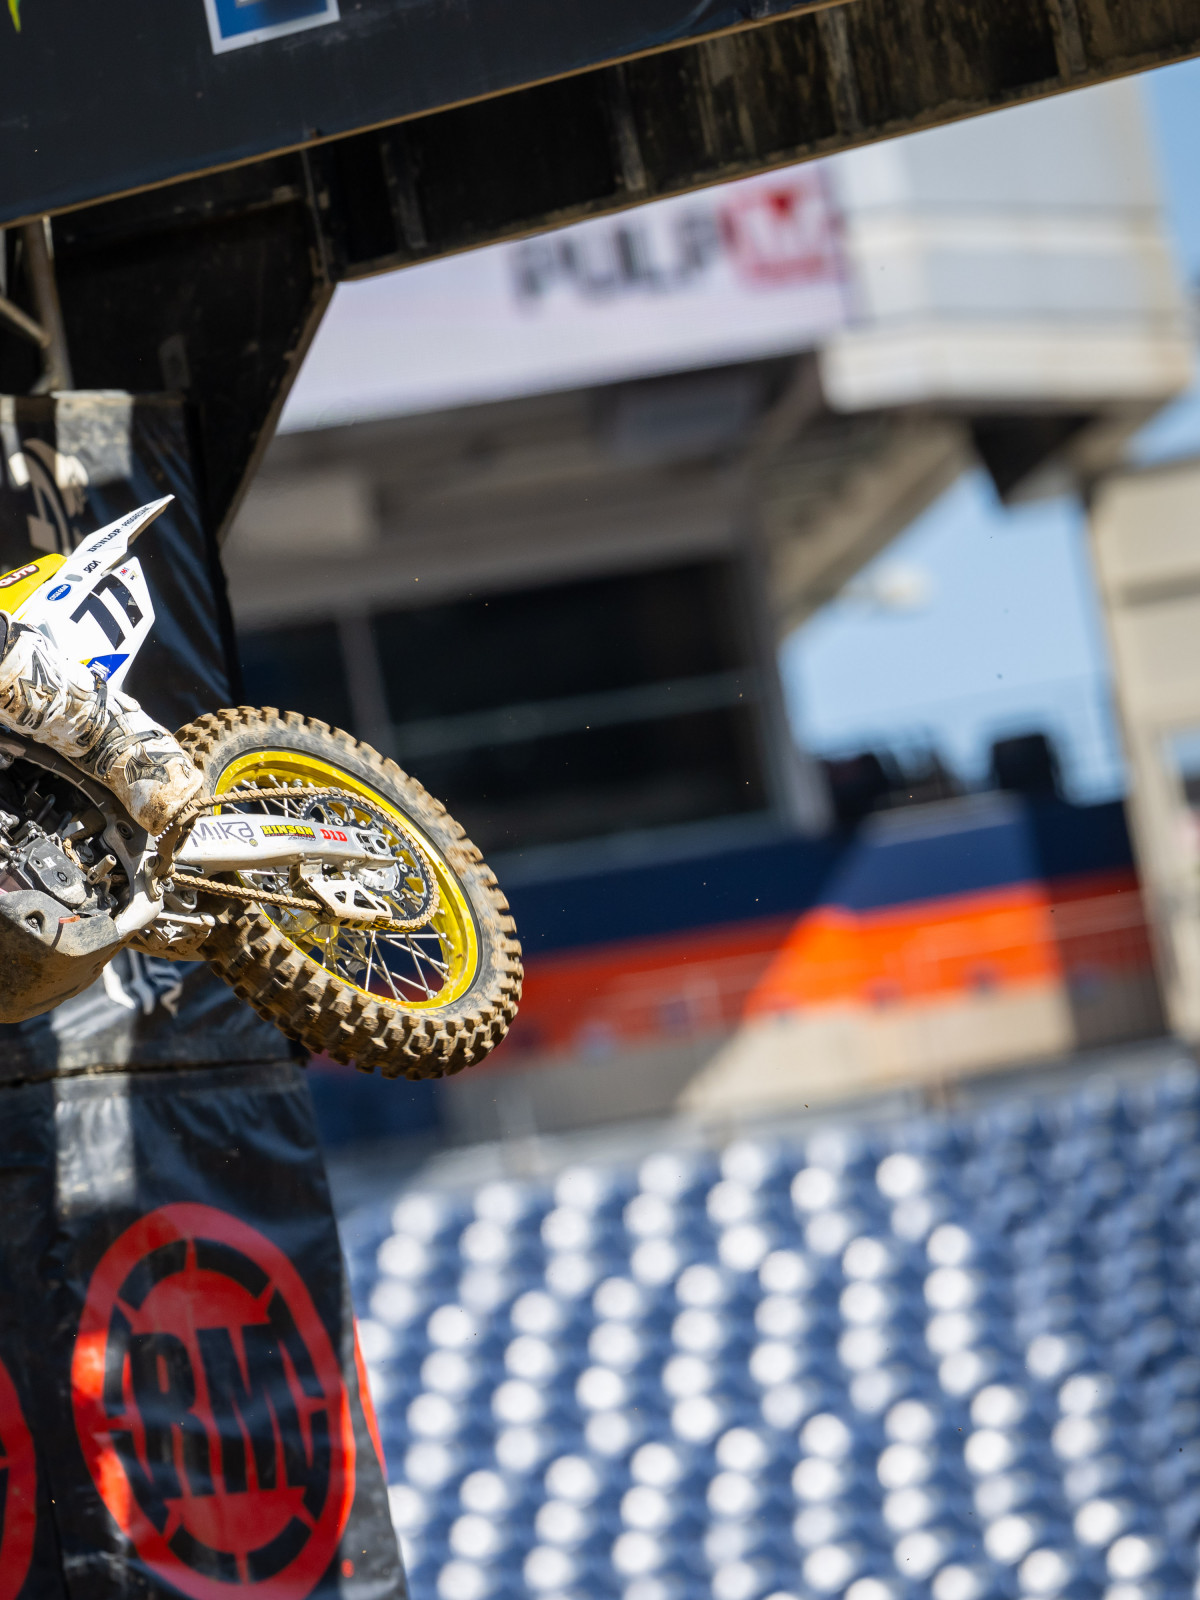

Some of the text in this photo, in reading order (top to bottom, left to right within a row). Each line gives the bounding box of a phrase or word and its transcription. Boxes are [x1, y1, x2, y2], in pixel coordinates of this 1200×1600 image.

[87, 528, 121, 553] DUNLOP
[70, 574, 143, 650] 77
[190, 820, 255, 848] Mika
[261, 824, 314, 837] HINSON
[319, 827, 348, 842] DID
[130, 1324, 325, 1503] RM
